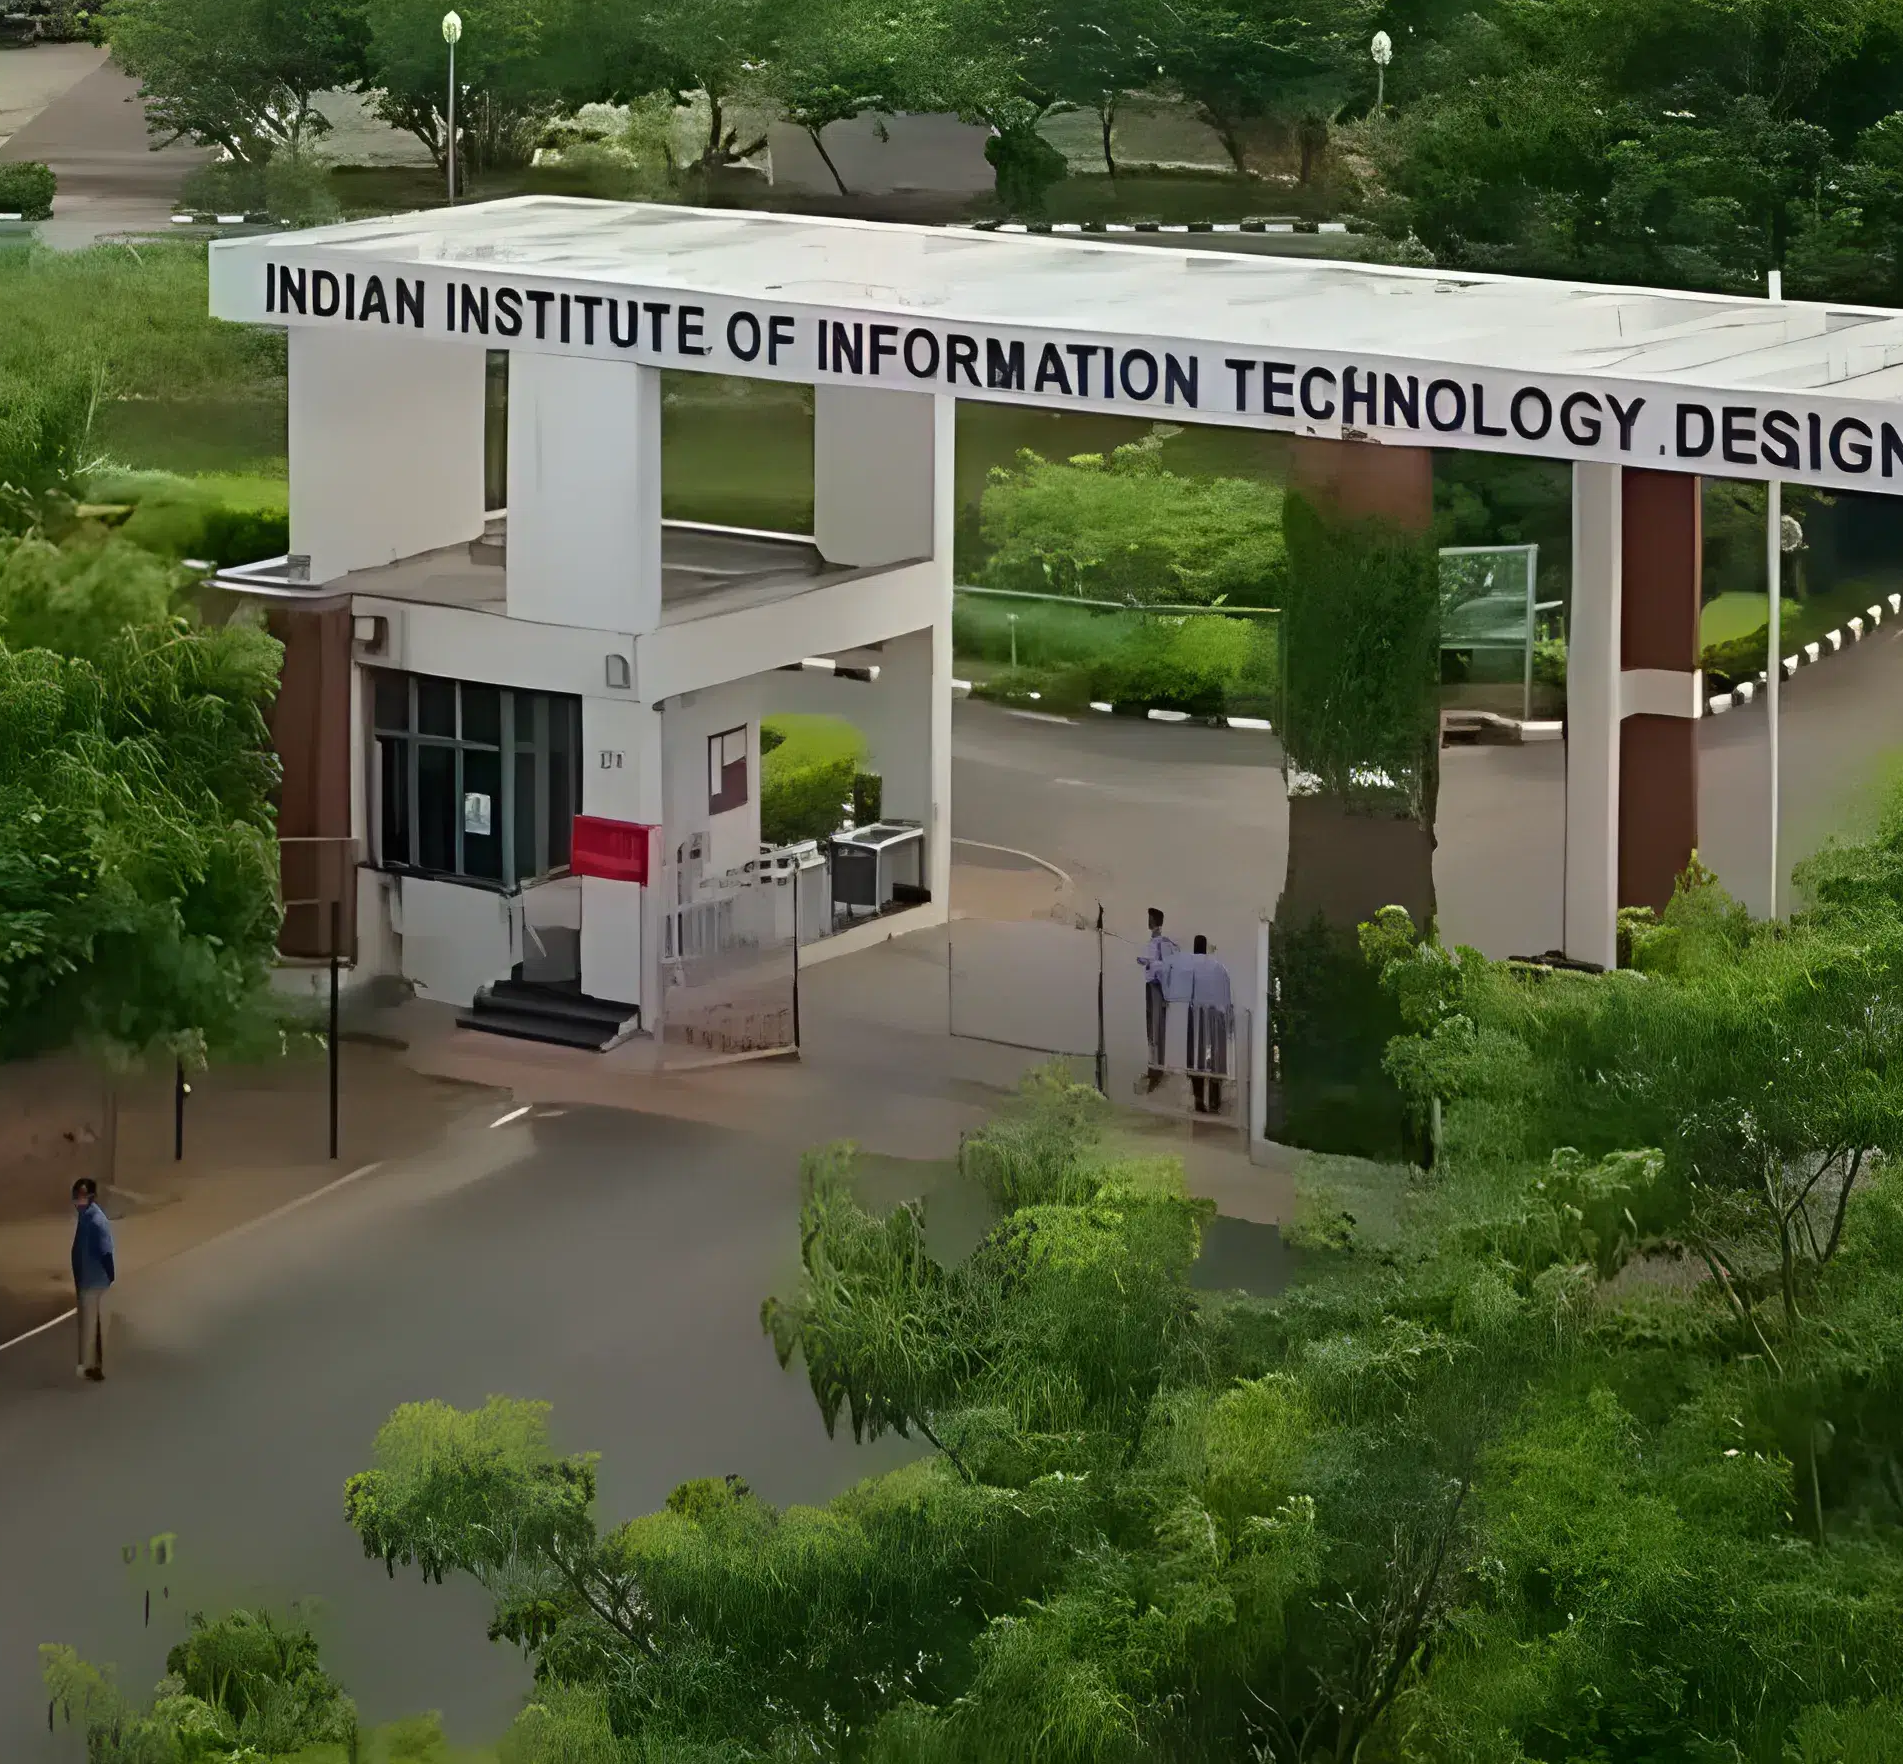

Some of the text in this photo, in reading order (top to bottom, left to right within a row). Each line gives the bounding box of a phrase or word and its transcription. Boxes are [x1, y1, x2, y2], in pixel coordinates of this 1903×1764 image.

[265, 262, 425, 329] INDIAN
[446, 282, 707, 357] INSTITUTE
[726, 310, 795, 367] OF
[817, 319, 1200, 409] INFORMATION
